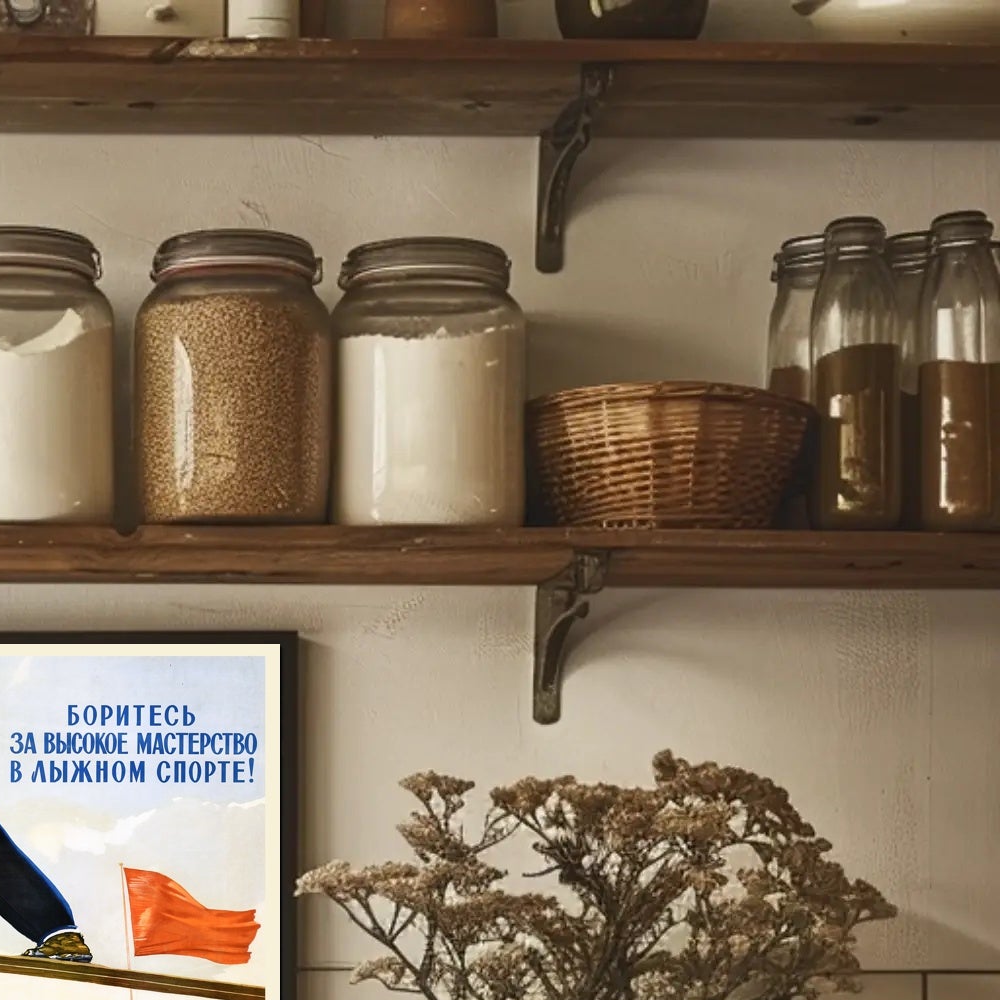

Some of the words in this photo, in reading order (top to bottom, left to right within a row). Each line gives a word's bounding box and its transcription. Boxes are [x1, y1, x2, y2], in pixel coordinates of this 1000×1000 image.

[67, 704, 196, 727] БОРИТЕСЬ
[9, 732, 37, 755] ЗА
[43, 732, 128, 755] ВЫСОКОЕ
[136, 732, 258, 755] МАСТЕРСТВО
[10, 760, 23, 783] В
[31, 760, 146, 783] ЛЫЖНОМ
[156, 757, 255, 783] СПОРТЕ!
